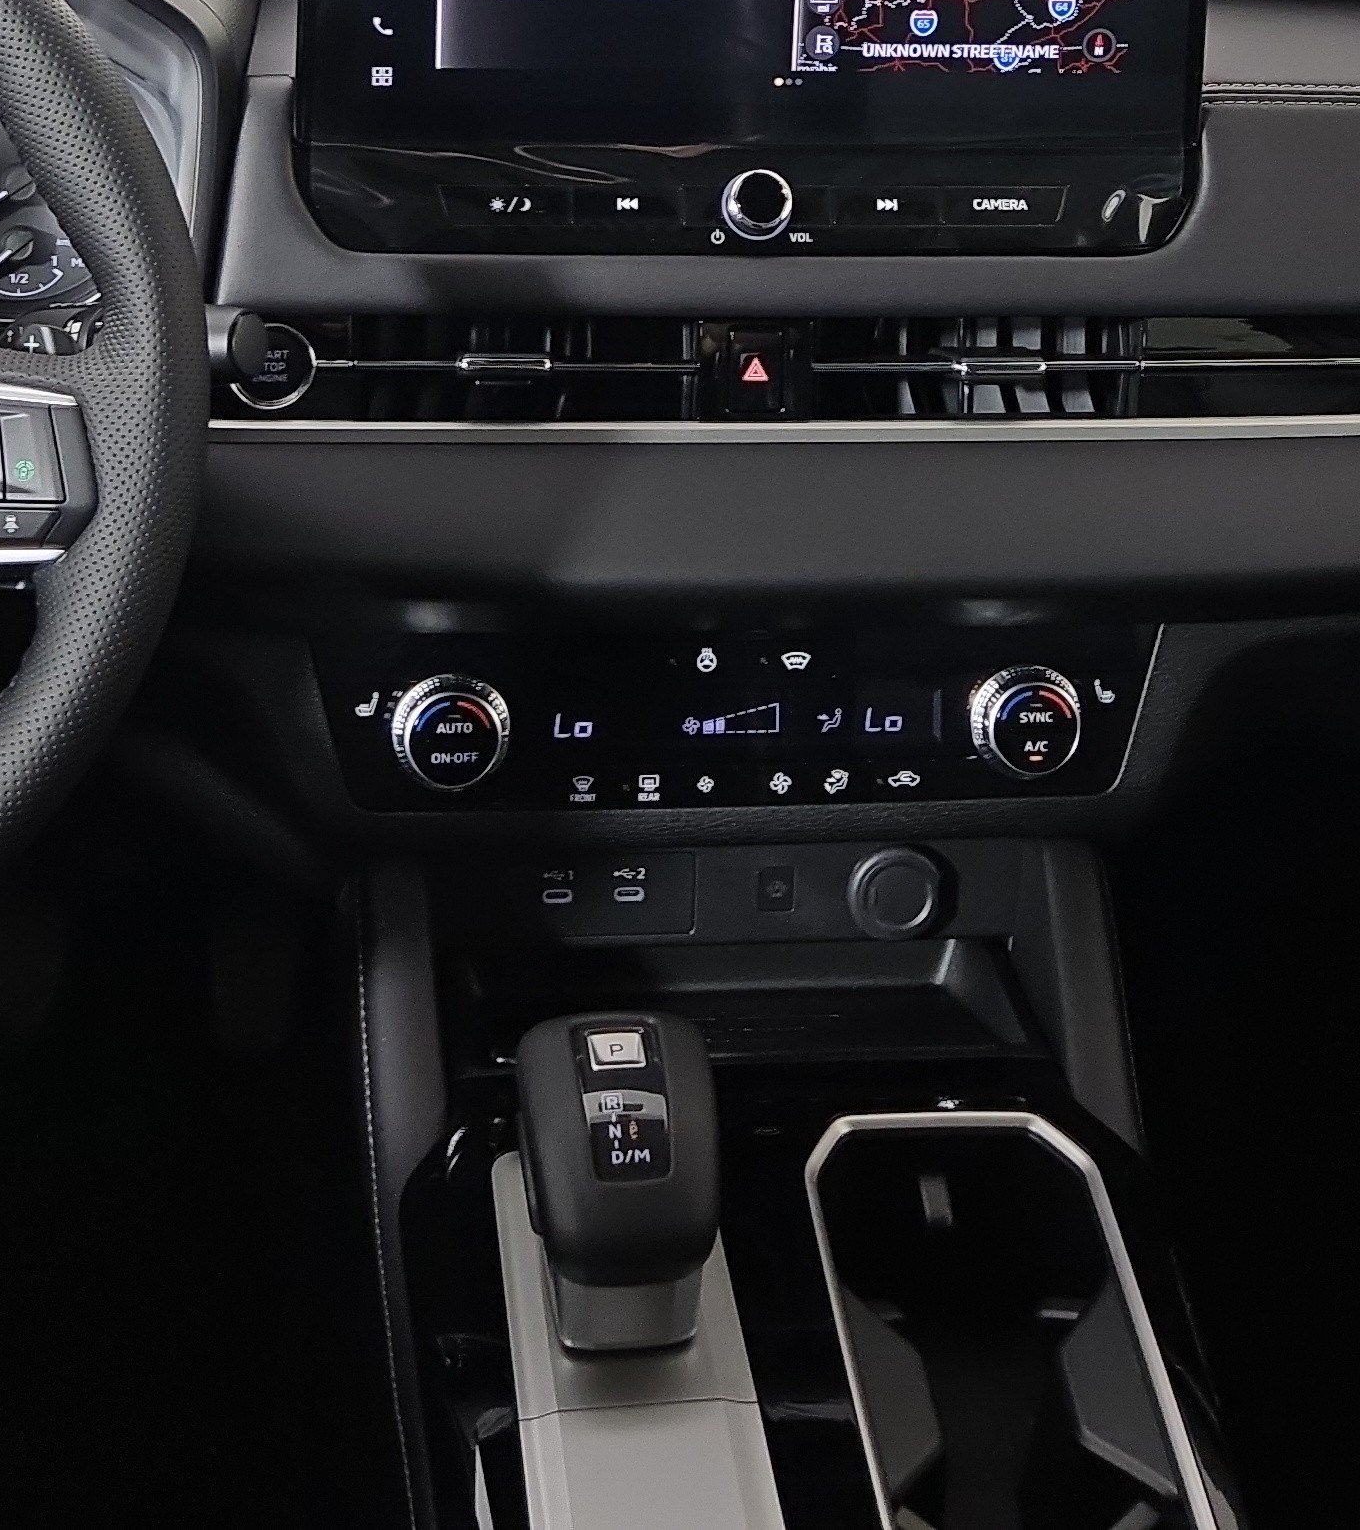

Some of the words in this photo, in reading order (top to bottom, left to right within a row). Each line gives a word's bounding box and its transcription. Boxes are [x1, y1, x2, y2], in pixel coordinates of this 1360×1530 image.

[862, 43, 951, 58] UNKNOWN
[952, 44, 1011, 59] STREET
[1012, 44, 1060, 59] NAME
[972, 198, 1029, 211] CAMERA
[788, 233, 814, 243] VOL
[50, 255, 59, 267] 1
[8, 273, 30, 284] 1/2
[266, 349, 289, 360] ART
[264, 361, 287, 372] TOP
[864, 707, 903, 732] Lo
[1018, 711, 1054, 723] SYNC
[435, 722, 474, 734] AUTO
[553, 713, 594, 738] Lo
[1023, 740, 1049, 753] A/C
[636, 867, 646, 880] 2
[609, 1043, 624, 1057] P
[606, 1097, 619, 1109] R
[608, 1124, 622, 1139] N
[611, 1148, 651, 1165] D/M
